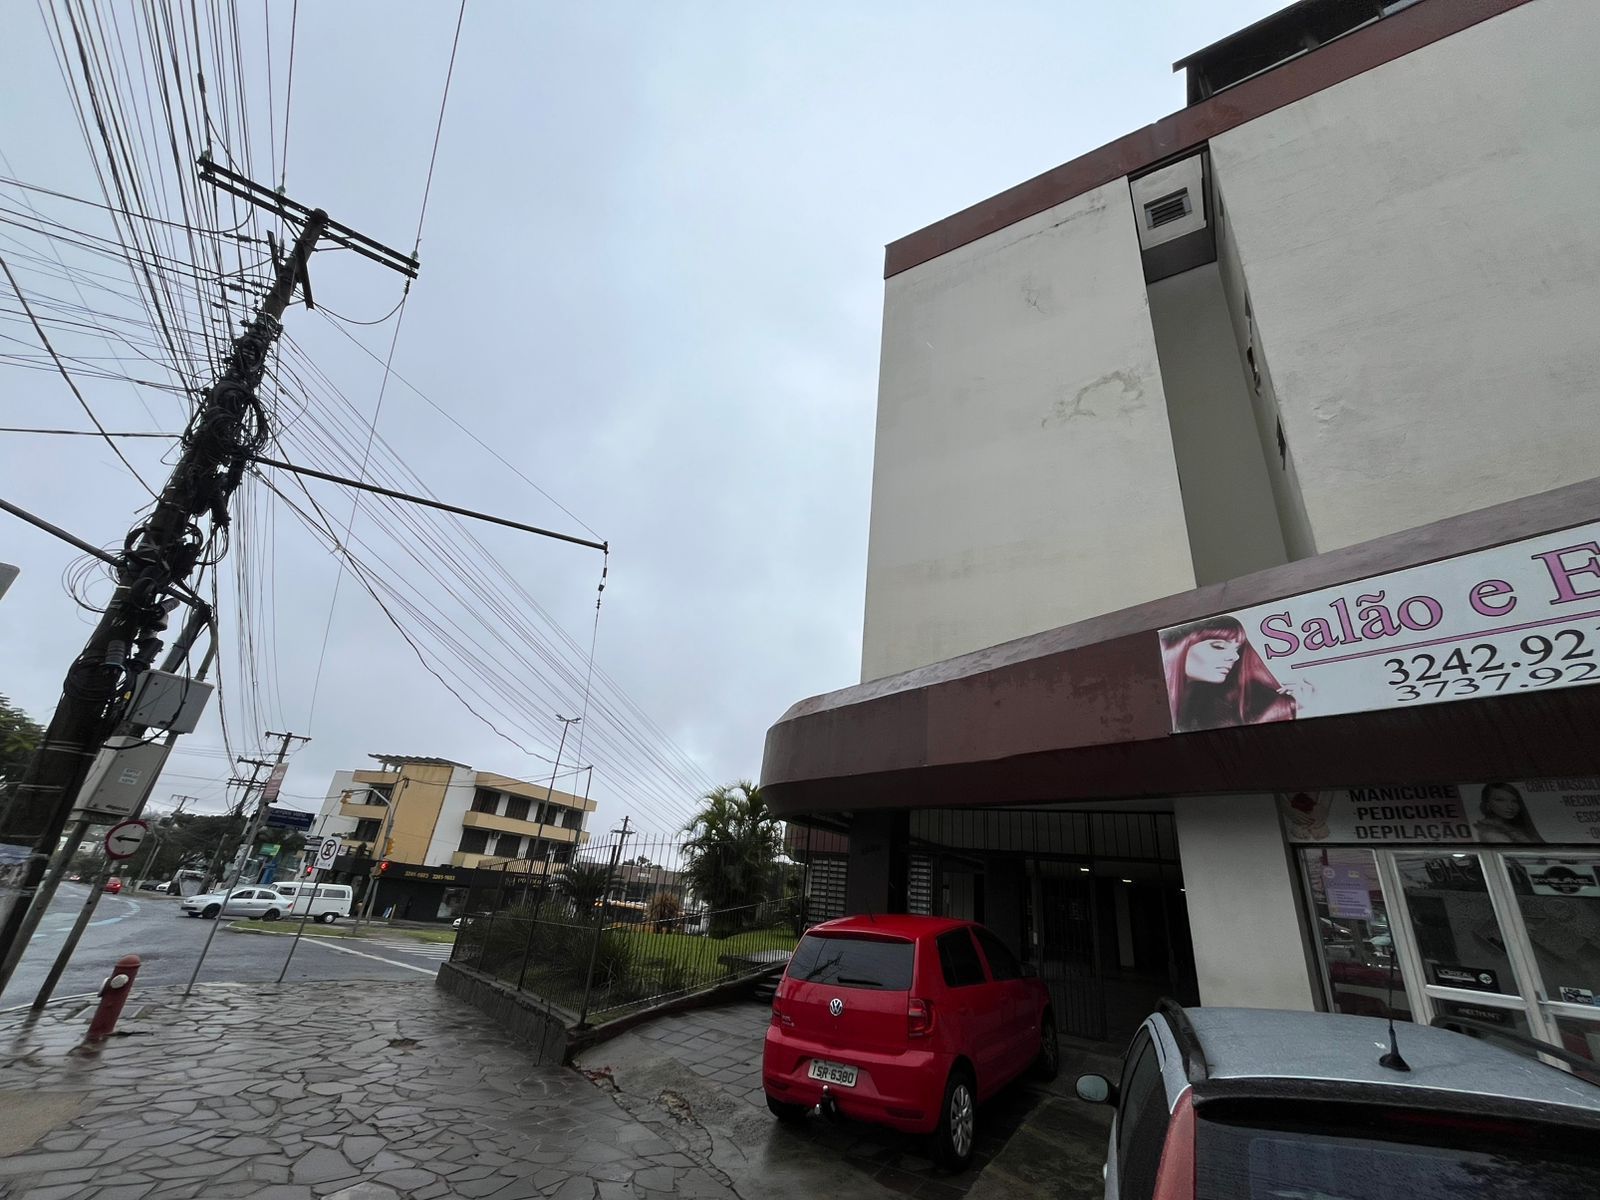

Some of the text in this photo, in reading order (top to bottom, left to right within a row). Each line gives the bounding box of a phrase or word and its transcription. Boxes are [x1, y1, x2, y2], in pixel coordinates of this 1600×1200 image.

[1260, 590, 1443, 659] Salão
[1468, 579, 1517, 616] e
[1384, 626, 1600, 685] 3242.92
[1349, 785, 1457, 802] MANICURE
[1357, 804, 1459, 820] PEDICURE
[1355, 822, 1473, 841] DEPILAÇÃO
